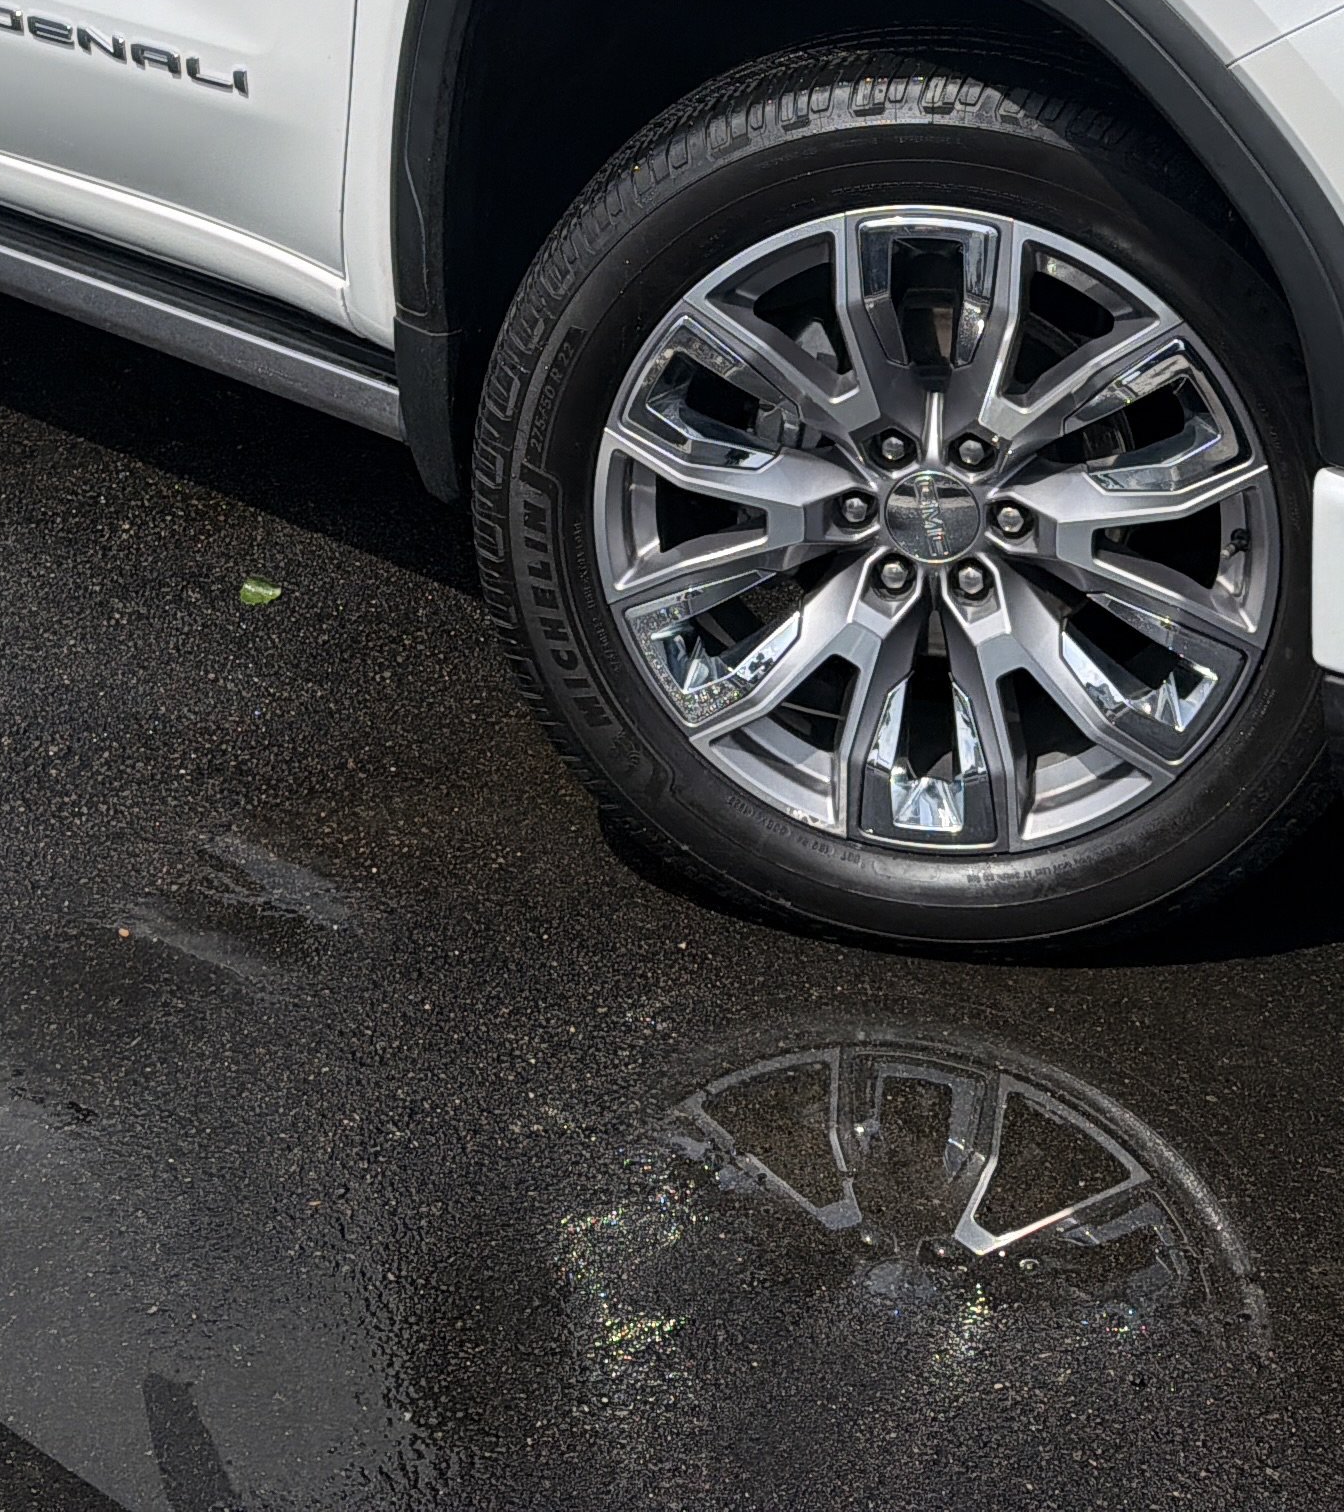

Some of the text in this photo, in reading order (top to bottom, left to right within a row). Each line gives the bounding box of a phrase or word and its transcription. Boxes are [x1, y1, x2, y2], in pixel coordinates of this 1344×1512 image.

[530, 341, 575, 453] 275/50 R 22
[523, 498, 613, 728] MICHELIN
